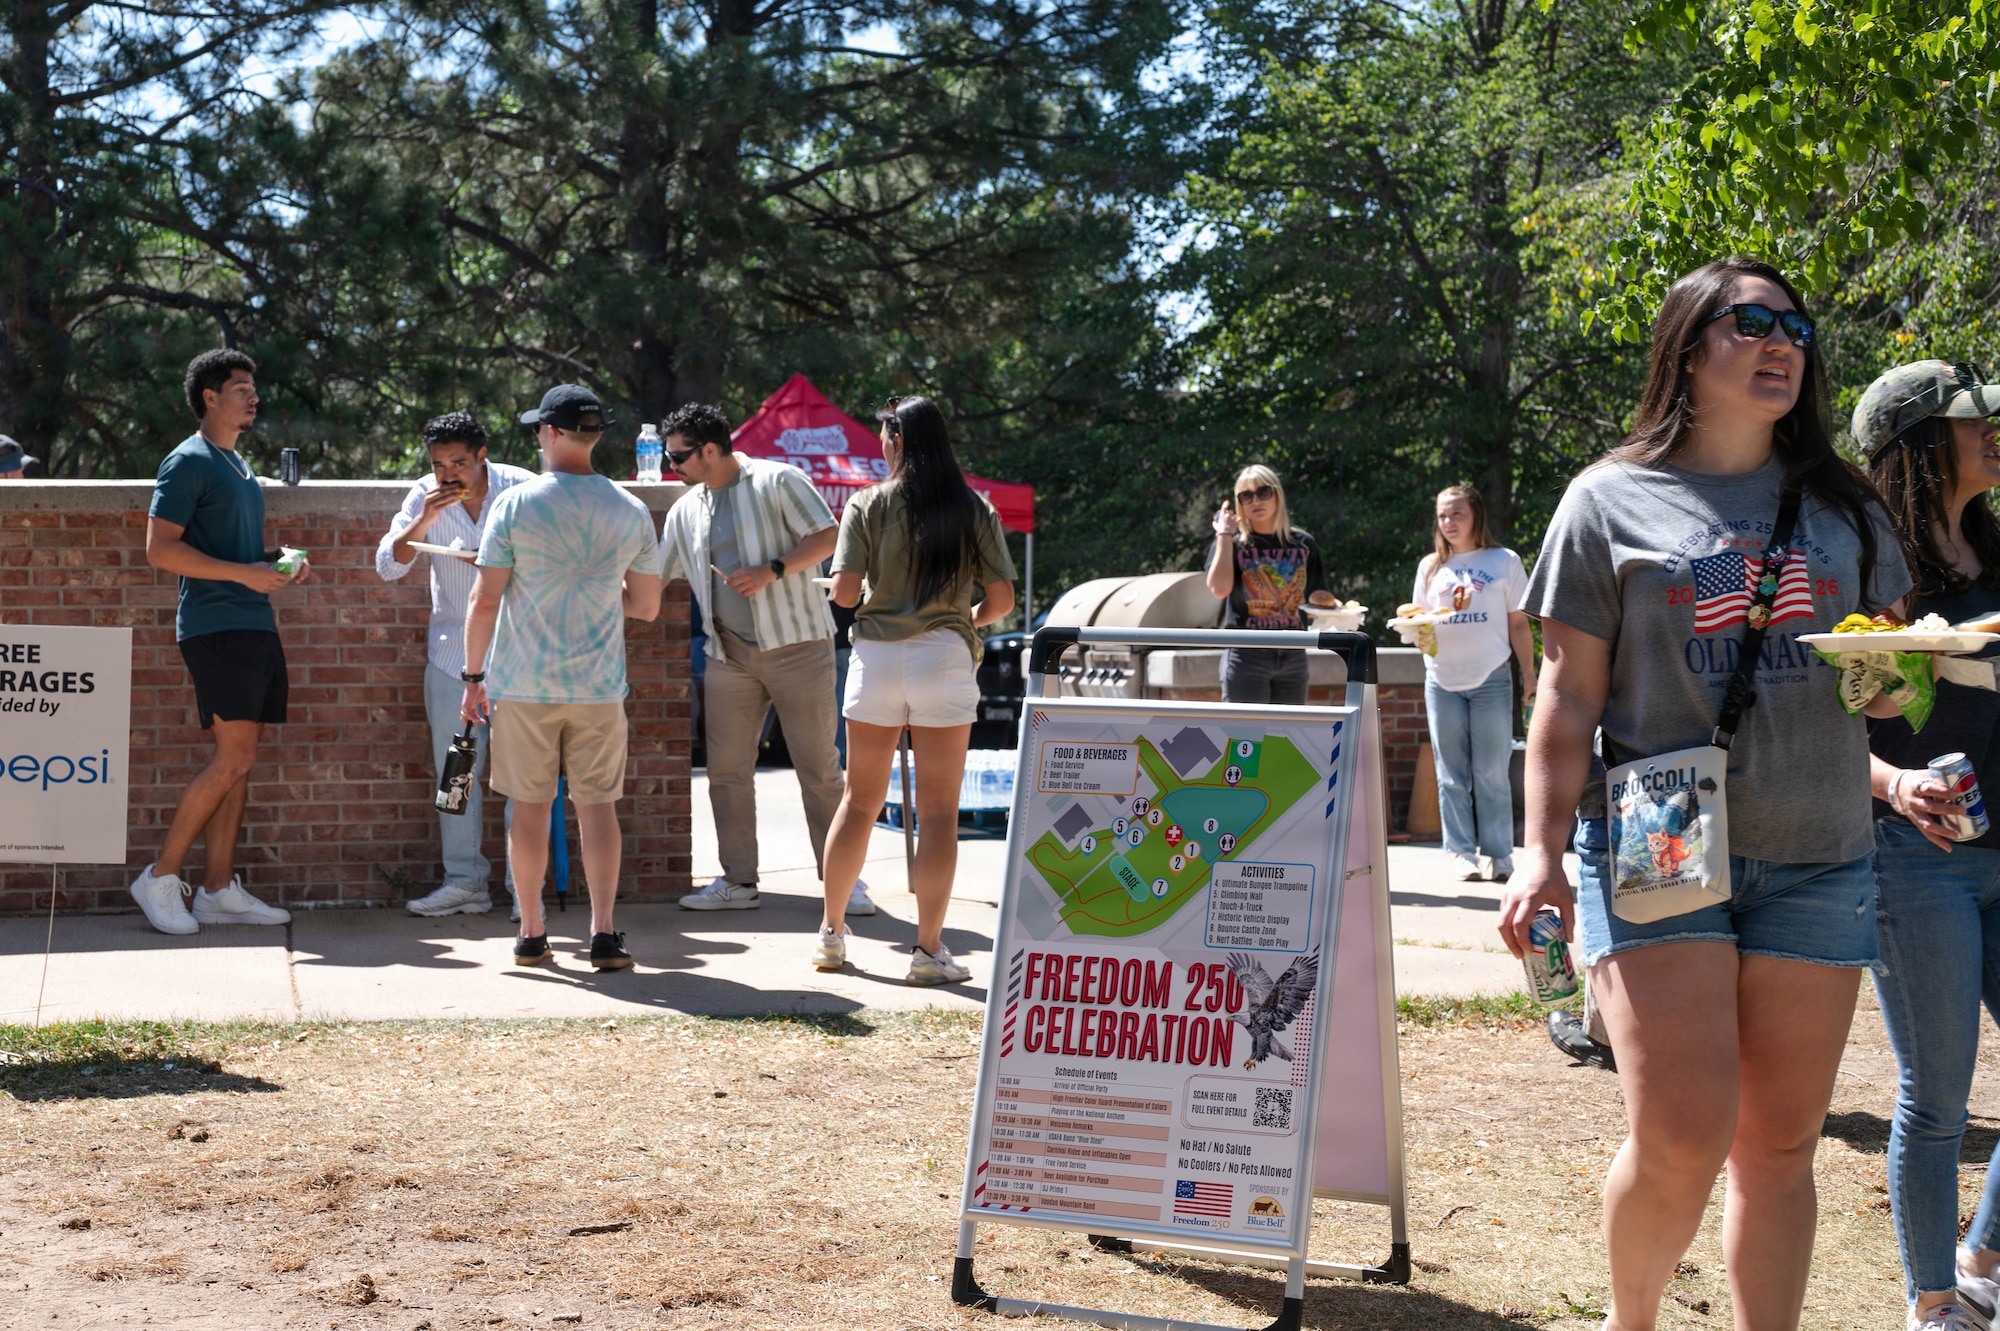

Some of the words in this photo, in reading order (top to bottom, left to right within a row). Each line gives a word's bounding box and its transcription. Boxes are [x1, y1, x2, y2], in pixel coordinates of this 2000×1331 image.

[1664, 520, 1750, 574] CELEBRATING
[1755, 521, 1772, 534] 25
[1792, 532, 1832, 565] YEARS
[1478, 569, 1494, 584] THE
[1815, 579, 1839, 597] 26
[1667, 588, 1694, 604] 20
[1441, 612, 1488, 625] LIZZIES
[0, 644, 40, 663] REE
[1685, 637, 1742, 674] OLD
[1755, 632, 1828, 671] NAV
[0, 670, 94, 693] RAGES
[1758, 674, 1808, 685] TRADITION
[0, 698, 35, 712] ided
[39, 698, 60, 717] by
[1053, 747, 1074, 758] FOOD
[1075, 748, 1081, 758] &
[1083, 748, 1127, 760] BEVERAGES
[1242, 743, 1249, 755] 9
[1064, 761, 1084, 769] Service
[1062, 771, 1080, 779] Trailer
[1062, 781, 1072, 789] Bell
[1083, 782, 1100, 790] Cream
[1612, 767, 1696, 802] BROCCOLI
[1152, 811, 1158, 823] 3
[1117, 820, 1123, 833] 5
[1208, 820, 1214, 831] 8
[1132, 830, 1138, 843] 6
[1085, 838, 1091, 850] 4
[1189, 844, 1194, 856] 1
[1174, 856, 1180, 869] 2
[1118, 866, 1141, 891] STAGE
[1241, 866, 1284, 879] ACTIVITIES
[1157, 881, 1163, 894] 7
[1221, 879, 1248, 888] Ultimate
[1249, 880, 1272, 890] Bungee
[1273, 881, 1307, 892] Trampoline
[1220, 890, 1247, 900] Climbing
[1249, 892, 1263, 900] Wall
[1219, 901, 1262, 911] Touch-A-Truck
[1217, 912, 1241, 921] Historic
[1243, 914, 1265, 923] Vehicle
[1267, 915, 1289, 925] Display
[1217, 924, 1240, 933] Bounce
[1241, 925, 1260, 934] Castle
[1261, 926, 1276, 935] Zone
[1216, 935, 1229, 943] Nerf
[1231, 936, 1252, 945] Battles
[1258, 937, 1274, 947] Open
[1275, 938, 1288, 948] Play
[1024, 953, 1173, 1008] FREEDOM
[1185, 962, 1244, 1013] 250
[1024, 1005, 1235, 1068] CELEBRATION
[1054, 1066, 1086, 1077] Schedule
[1086, 1069, 1094, 1078] of
[1095, 1070, 1117, 1080] Events
[1095, 1085, 1108, 1093] Party
[1053, 1094, 1063, 1102] High
[1064, 1095, 1083, 1103] Frontier
[1098, 1098, 1112, 1106] Guard
[1113, 1099, 1144, 1108] Presentation
[1192, 1090, 1209, 1099] SCAN
[1209, 1091, 1224, 1101] HERE
[1225, 1093, 1237, 1102] FOR
[1051, 1107, 1068, 1115] Playing
[1085, 1110, 1105, 1118] National
[1106, 1112, 1125, 1120] Anthem
[1191, 1104, 1205, 1114] FULL
[1206, 1105, 1223, 1115] EVENT
[1224, 1107, 1247, 1117] DETAILS
[1063, 1134, 1075, 1142] Band
[1047, 1146, 1066, 1154] Carnival
[1091, 1150, 1118, 1159] Inflatables
[1118, 1152, 1131, 1160] Open
[1179, 1138, 1190, 1150] No
[1192, 1140, 1206, 1152] Hat
[1213, 1142, 1224, 1153] No
[1225, 1143, 1251, 1156] Salute
[1045, 1158, 1055, 1166] Free
[1069, 1161, 1086, 1169] Service
[1178, 1157, 1188, 1168] No
[1190, 1158, 1221, 1171] Coolers
[1228, 1162, 1239, 1173] No
[1240, 1163, 1258, 1175] Pets
[1259, 1164, 1292, 1178] Allowed
[1055, 1173, 1077, 1181] Available
[1086, 1176, 1108, 1184] Purchase
[1049, 1185, 1063, 1193] Prime
[1248, 1184, 1280, 1195] SPONSORED
[1281, 1187, 1289, 1196] BY
[1040, 1198, 1058, 1206] Voodoo
[1059, 1200, 1082, 1208] Mountain
[1083, 1202, 1095, 1210] Band
[1172, 1215, 1210, 1226] Freedom
[1210, 1219, 1230, 1231] 250
[1247, 1215, 1265, 1225] Blue
